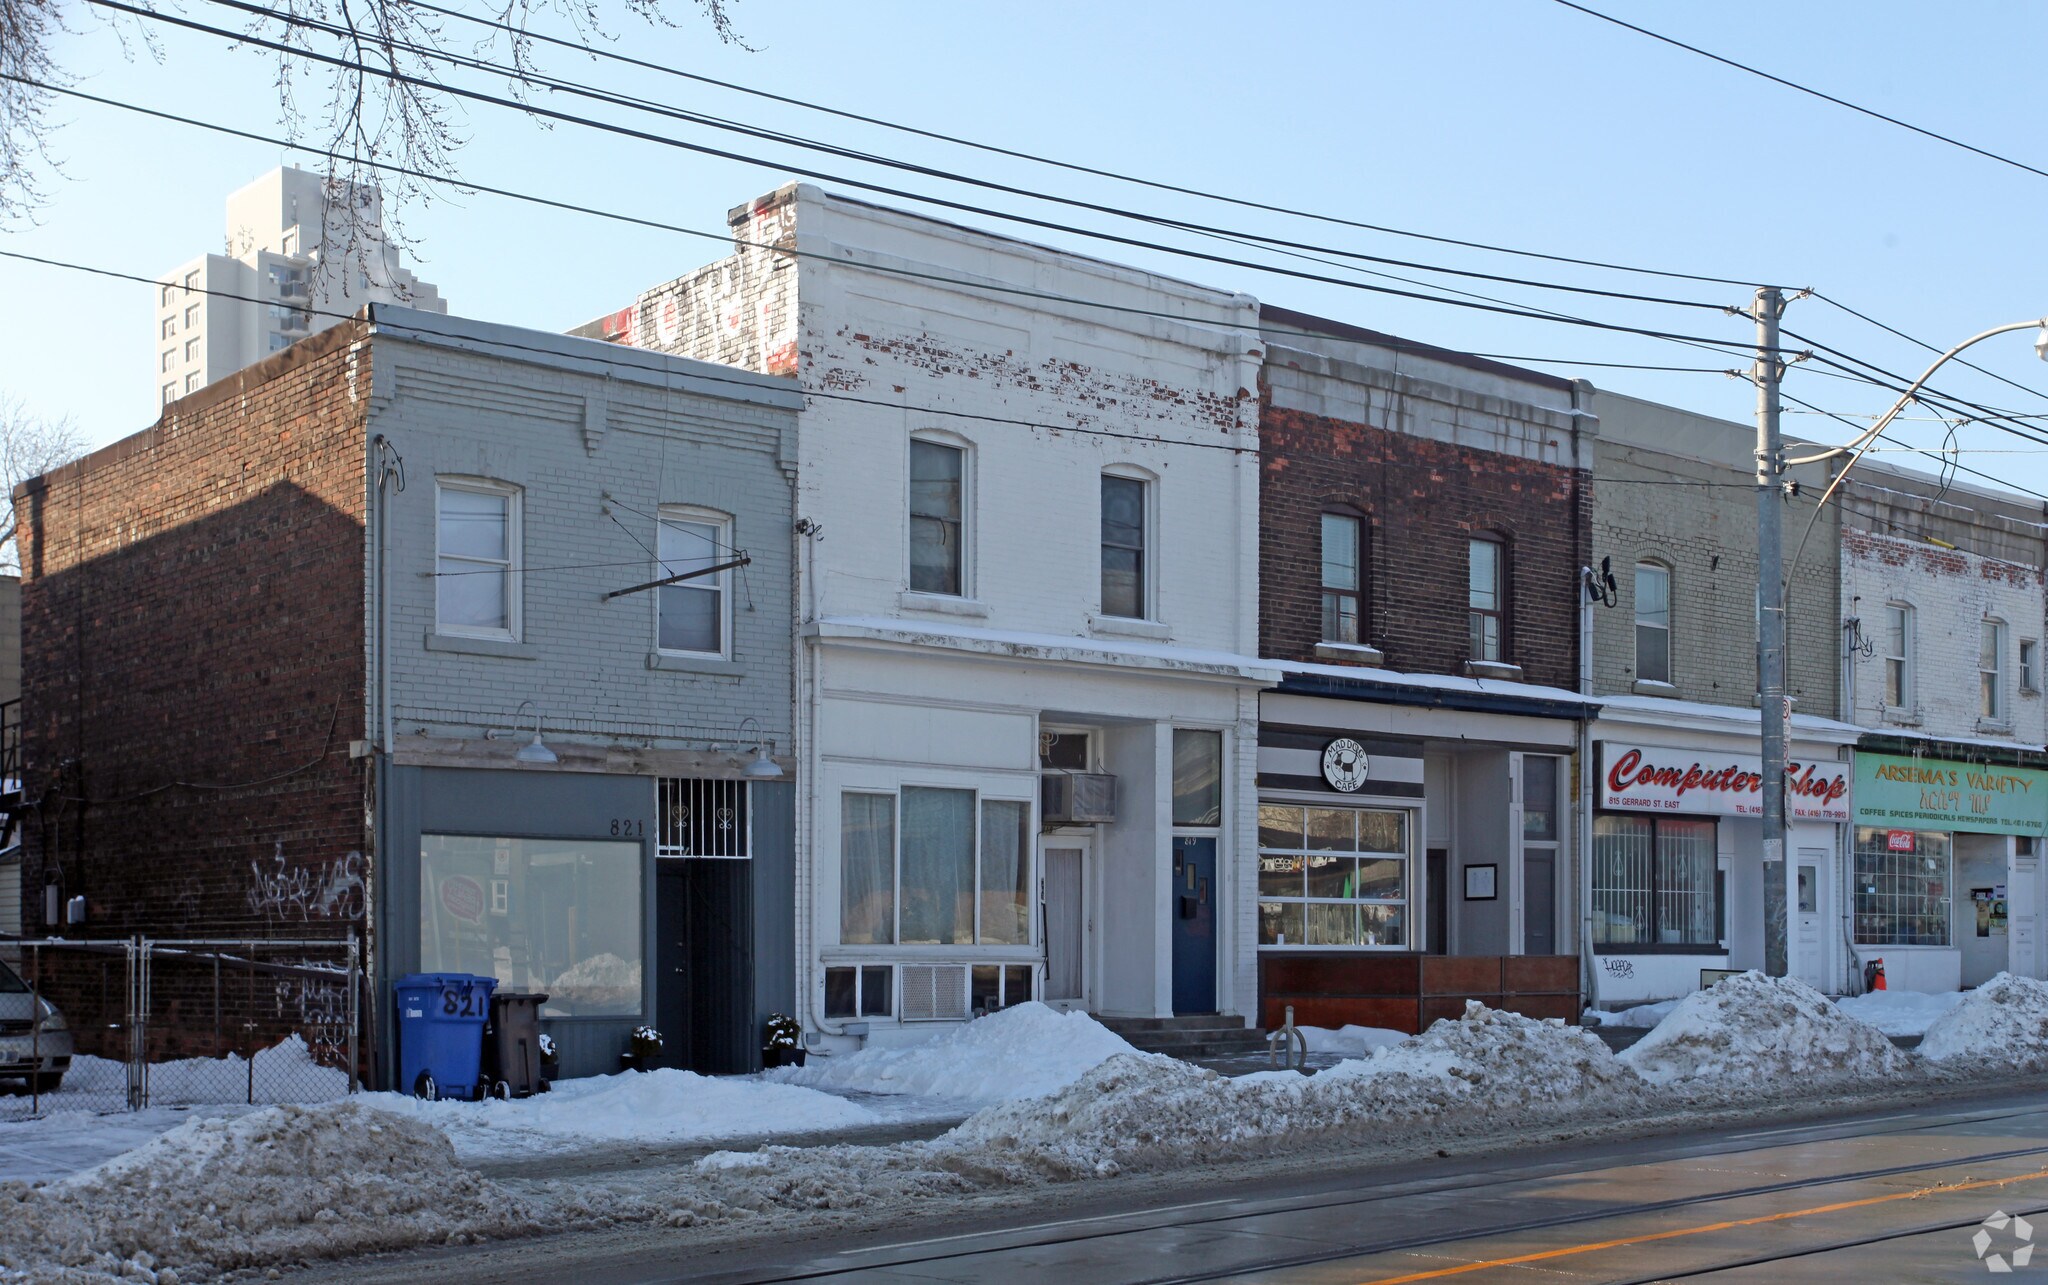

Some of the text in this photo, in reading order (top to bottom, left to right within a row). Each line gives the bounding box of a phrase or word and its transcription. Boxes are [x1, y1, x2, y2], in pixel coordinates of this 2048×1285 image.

[1327, 739, 1364, 759] MAD DOG
[1608, 749, 1763, 797] Computer
[1875, 763, 1958, 787] ARSEMA'S
[1335, 780, 1359, 790] CAFE
[1608, 797, 1619, 805] 815
[1622, 798, 1651, 806] GERRARD
[1860, 808, 1886, 816] COFFEE
[1889, 810, 1914, 818] SPICES
[1914, 812, 1956, 821] PERIODICALS
[610, 819, 644, 836] 821
[443, 990, 484, 1018] 821
